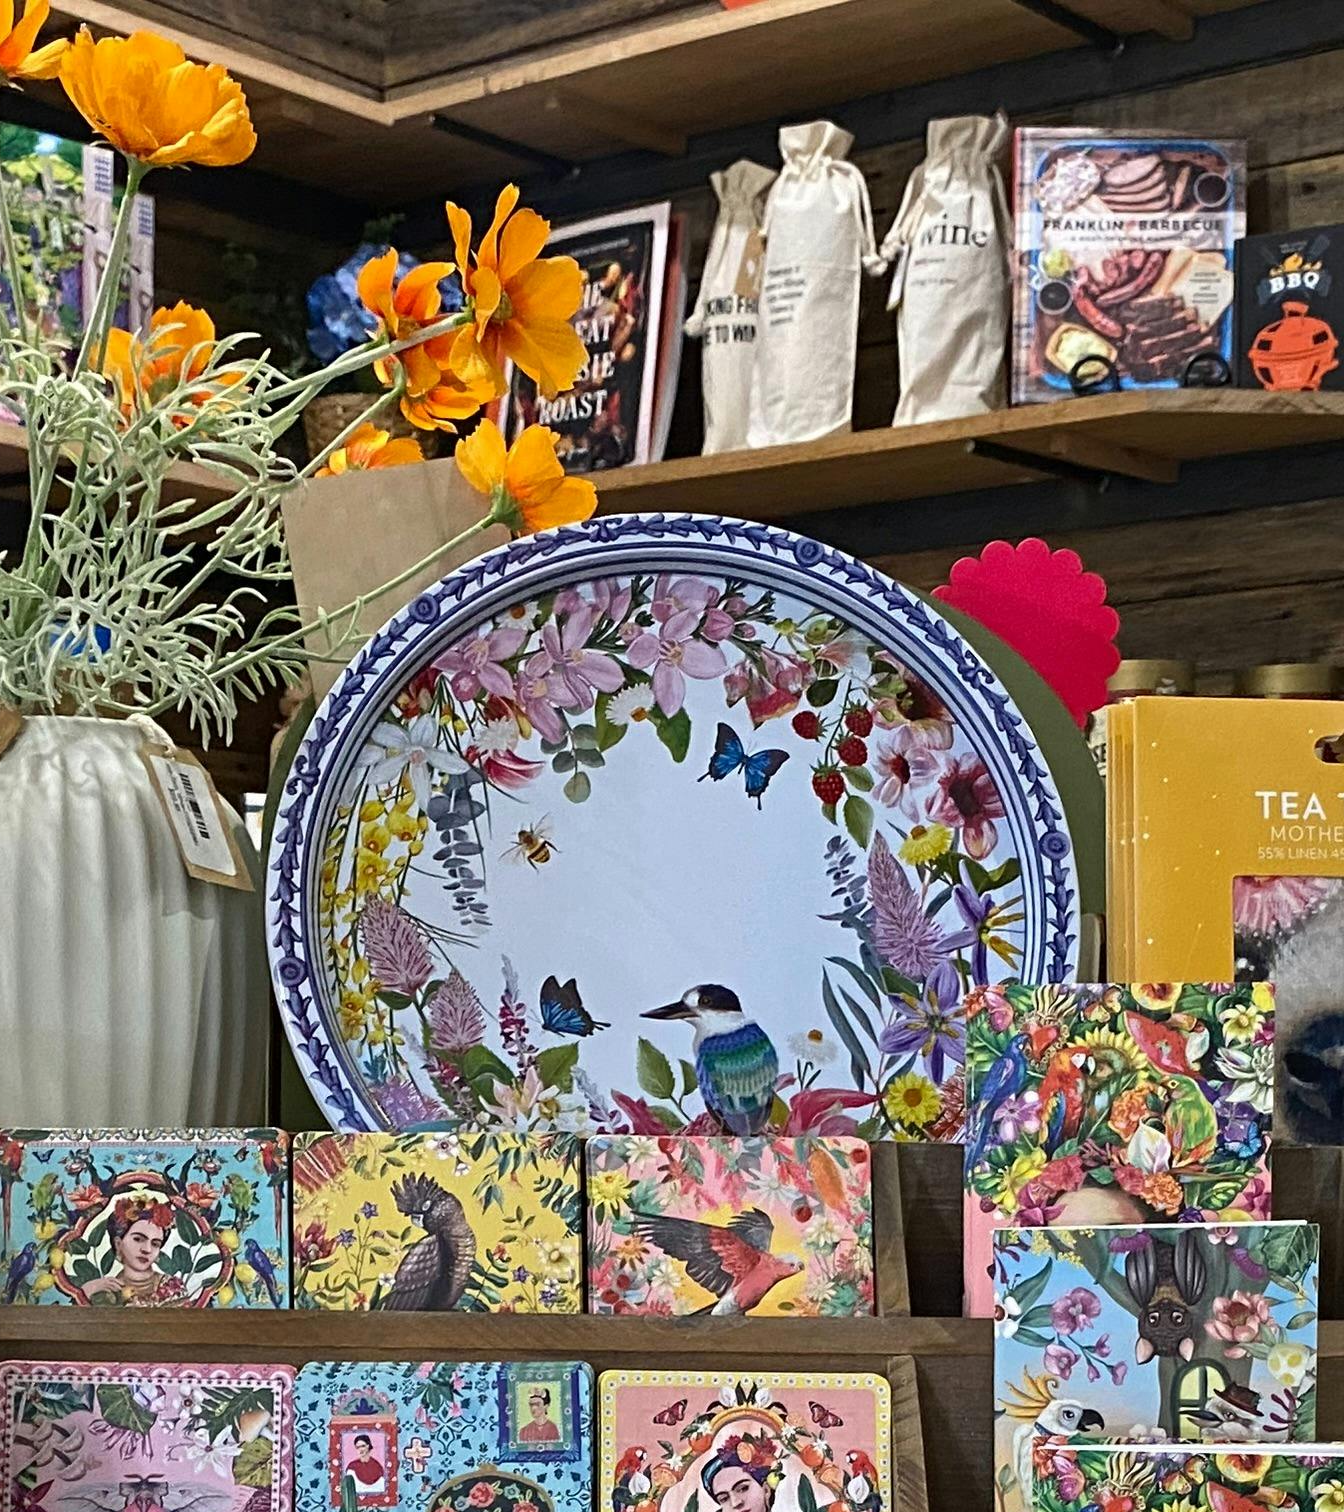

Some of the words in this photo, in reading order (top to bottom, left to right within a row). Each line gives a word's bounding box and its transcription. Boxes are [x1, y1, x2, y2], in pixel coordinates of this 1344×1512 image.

[921, 213, 988, 248] wine
[1043, 219, 1125, 232] FRANKLIN
[1138, 219, 1222, 233] BARBECUE
[1269, 271, 1320, 294] BBQ
[535, 389, 608, 425] ROAST
[1254, 791, 1327, 821] TEA
[1257, 847, 1287, 860] 55%
[1287, 848, 1328, 860] LINEN
